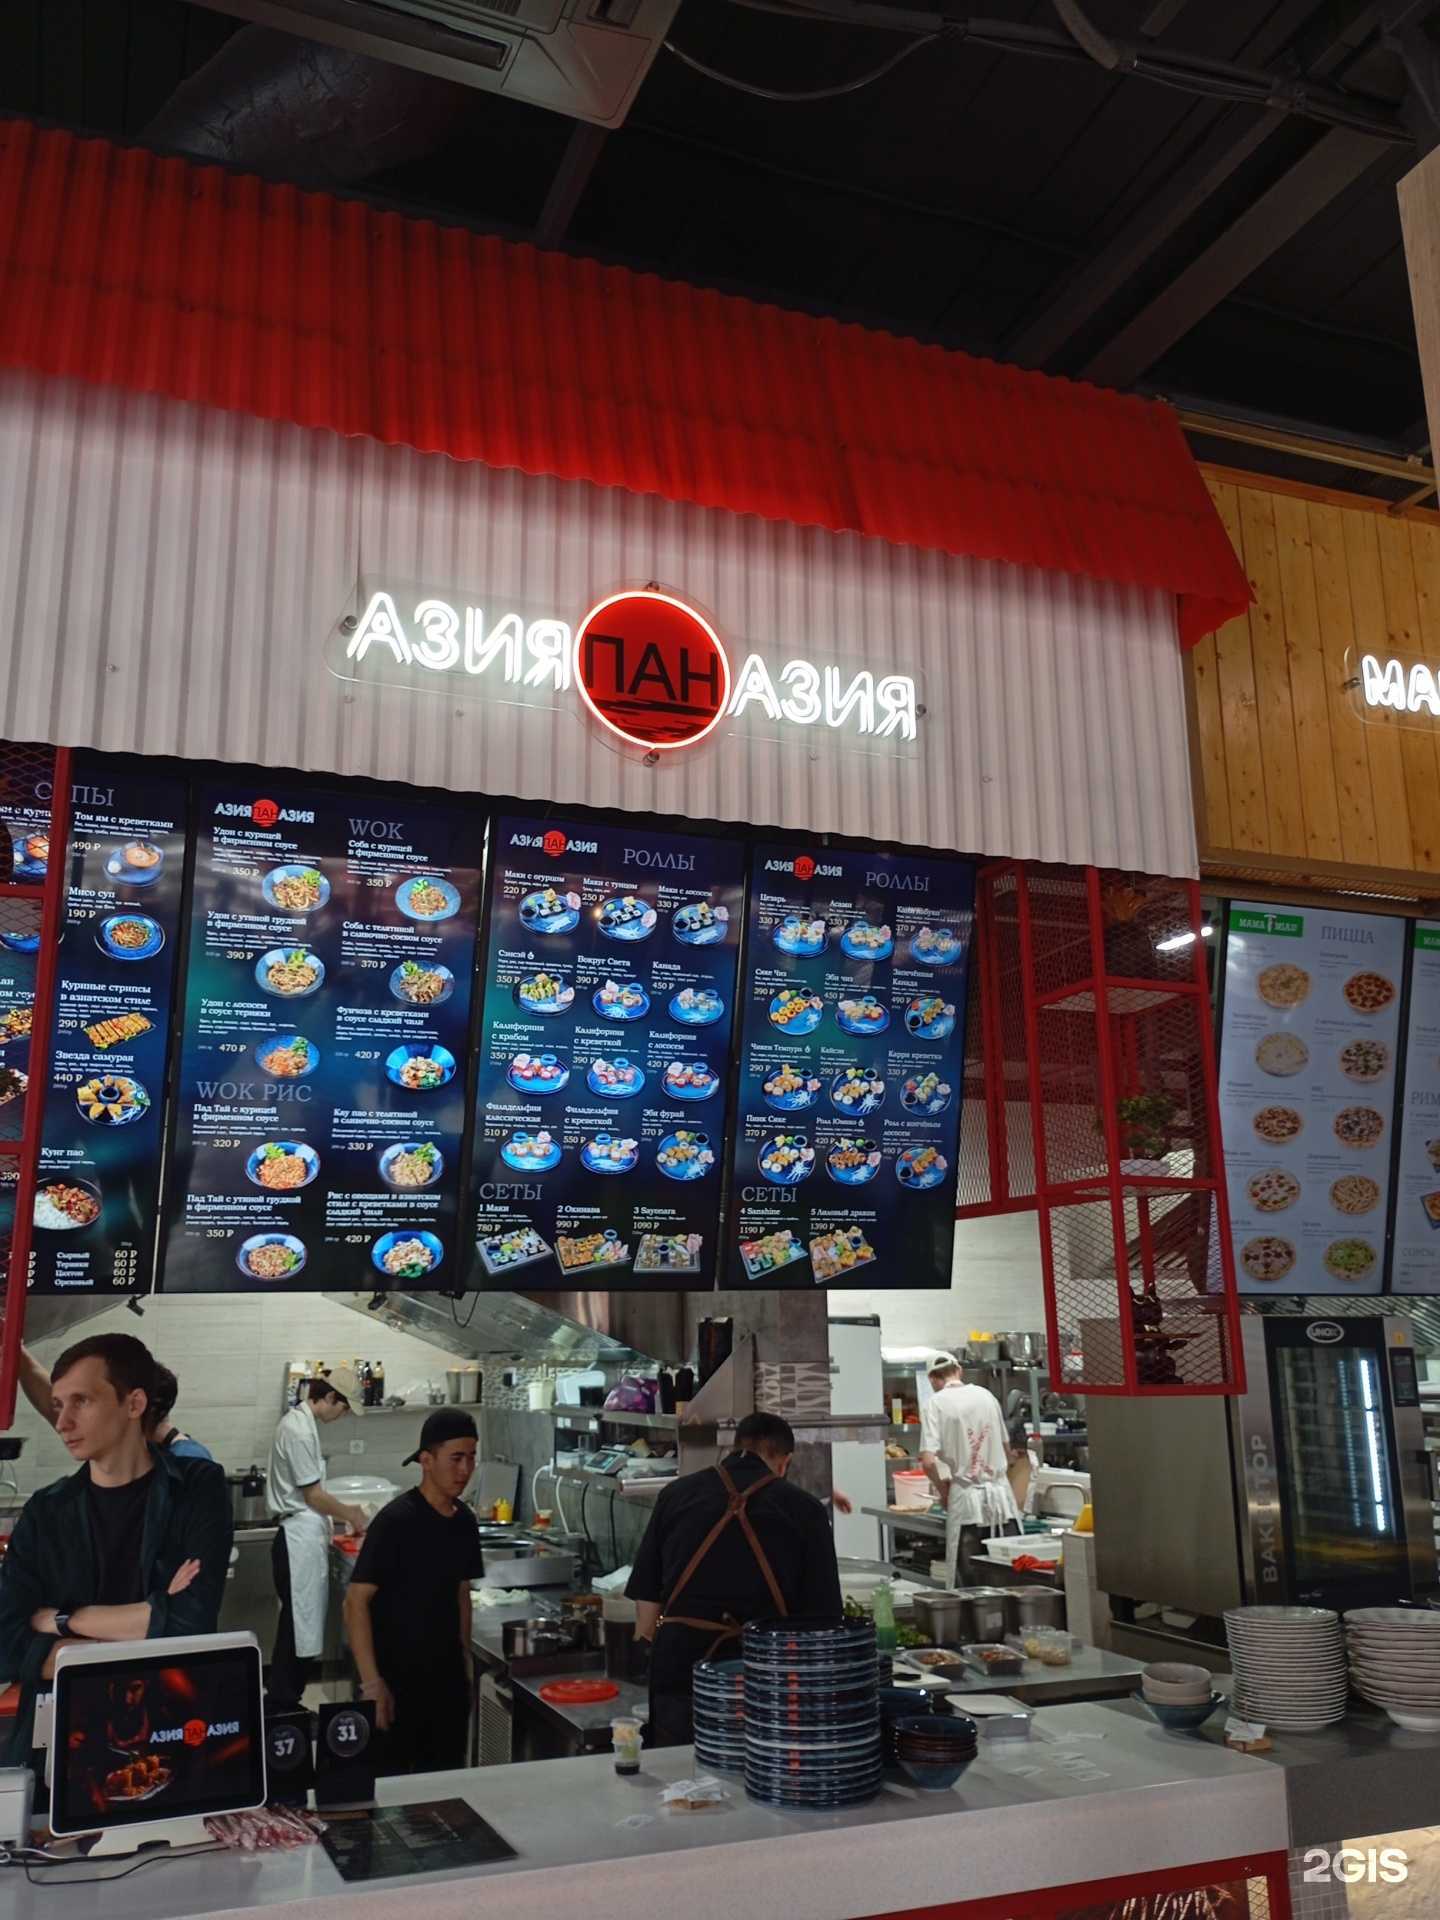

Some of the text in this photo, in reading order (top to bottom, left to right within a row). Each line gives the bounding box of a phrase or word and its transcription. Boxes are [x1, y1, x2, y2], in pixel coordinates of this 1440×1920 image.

[346, 592, 918, 741] АЗИЯ ПАН АЗИЯ
[34, 782, 115, 807] СПЫ
[214, 803, 252, 817] АЗИЯ
[278, 809, 315, 823] АЗИЯ
[349, 818, 403, 839] WOK
[510, 833, 598, 854] АЗИЯ АЗИЯ
[623, 848, 696, 871] РОЛЛЫ
[765, 860, 842, 877] АЗИЯ АЗИЯ
[865, 872, 930, 891] РОЛЛЫ
[196, 1080, 312, 1102] WOK РИС
[479, 1183, 543, 1200] СЕТЫ
[741, 1187, 797, 1202] СЕТЫ
[150, 1728, 183, 1744] АЗИЯ
[207, 1721, 240, 1737] АЗИЯ
[337, 1725, 358, 1741] 31
[275, 1738, 296, 1757] 37
